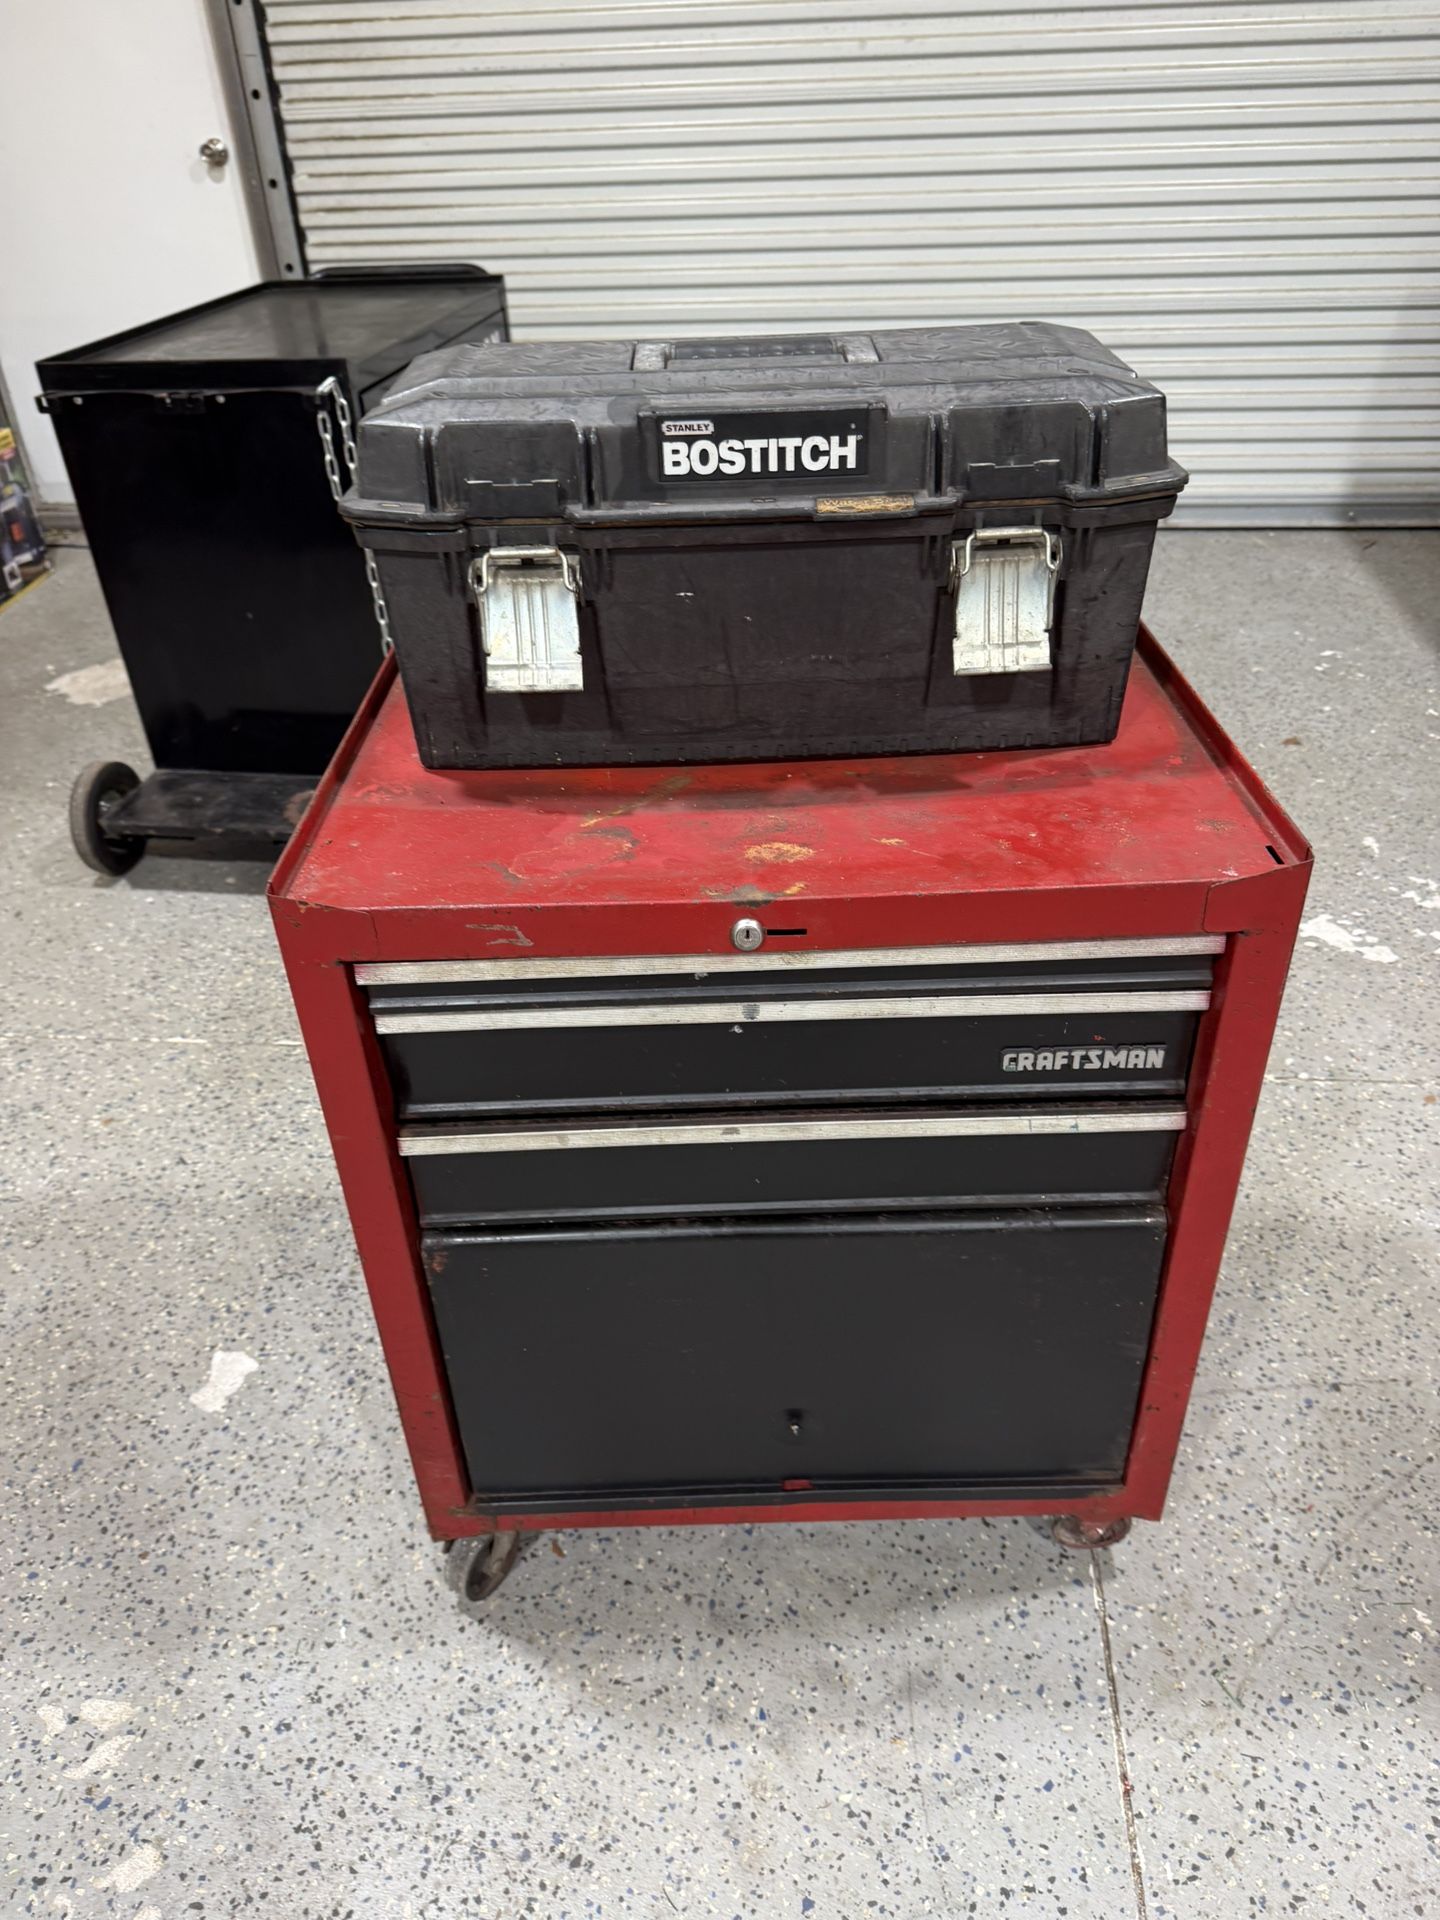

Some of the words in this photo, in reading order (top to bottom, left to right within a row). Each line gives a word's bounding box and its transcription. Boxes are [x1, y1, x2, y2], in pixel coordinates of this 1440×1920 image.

[665, 423, 710, 433] STANLEY
[662, 435, 857, 476] BOSTITCH
[1002, 1049, 1165, 1072] CRAFTSMAN
